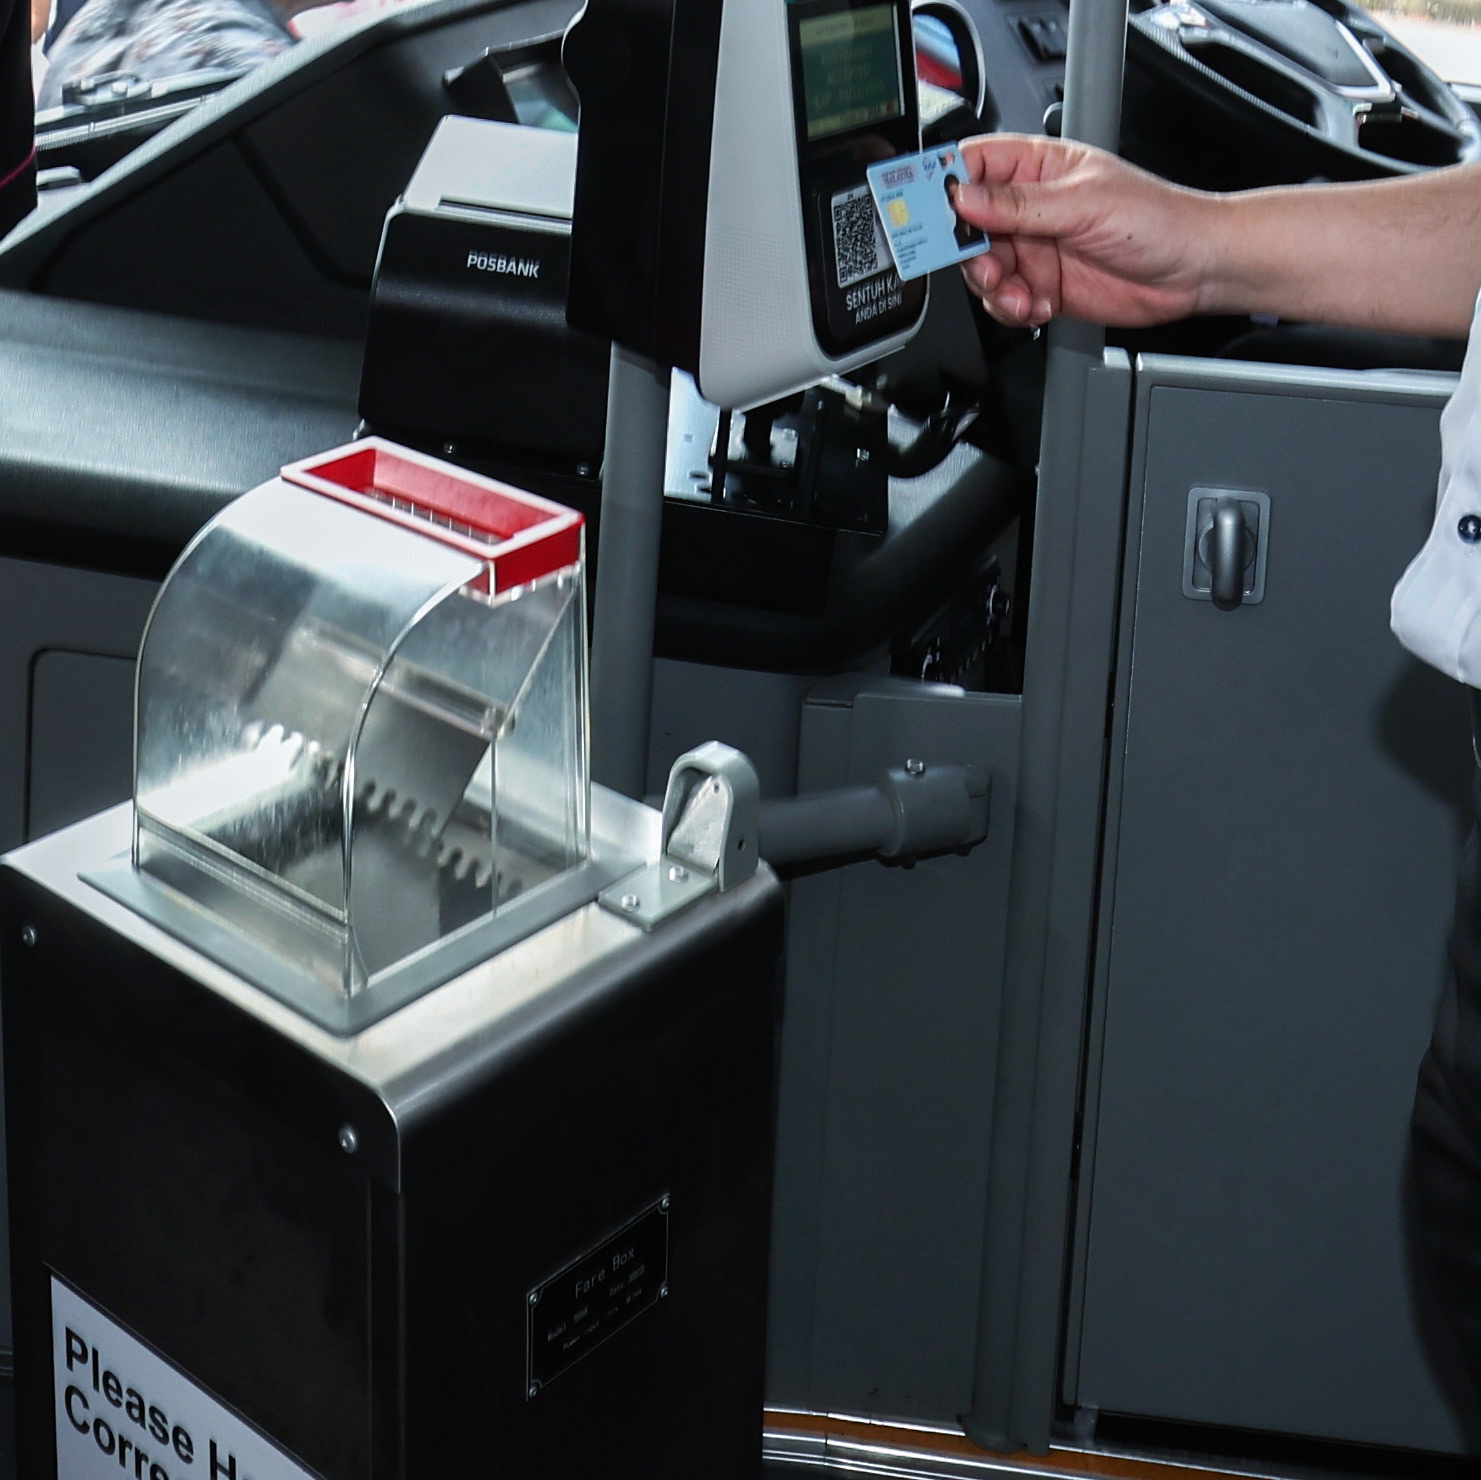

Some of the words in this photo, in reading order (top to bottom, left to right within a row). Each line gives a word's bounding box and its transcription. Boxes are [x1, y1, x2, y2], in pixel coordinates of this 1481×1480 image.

[466, 252, 540, 279] POSBANK
[845, 277, 886, 311] SENTUH
[855, 302, 878, 325] ANDA
[878, 297, 887, 315] DI
[887, 290, 902, 310] SINI
[575, 1270, 605, 1298] Fare
[612, 1247, 635, 1271] Box
[65, 1326, 194, 1464] Please
